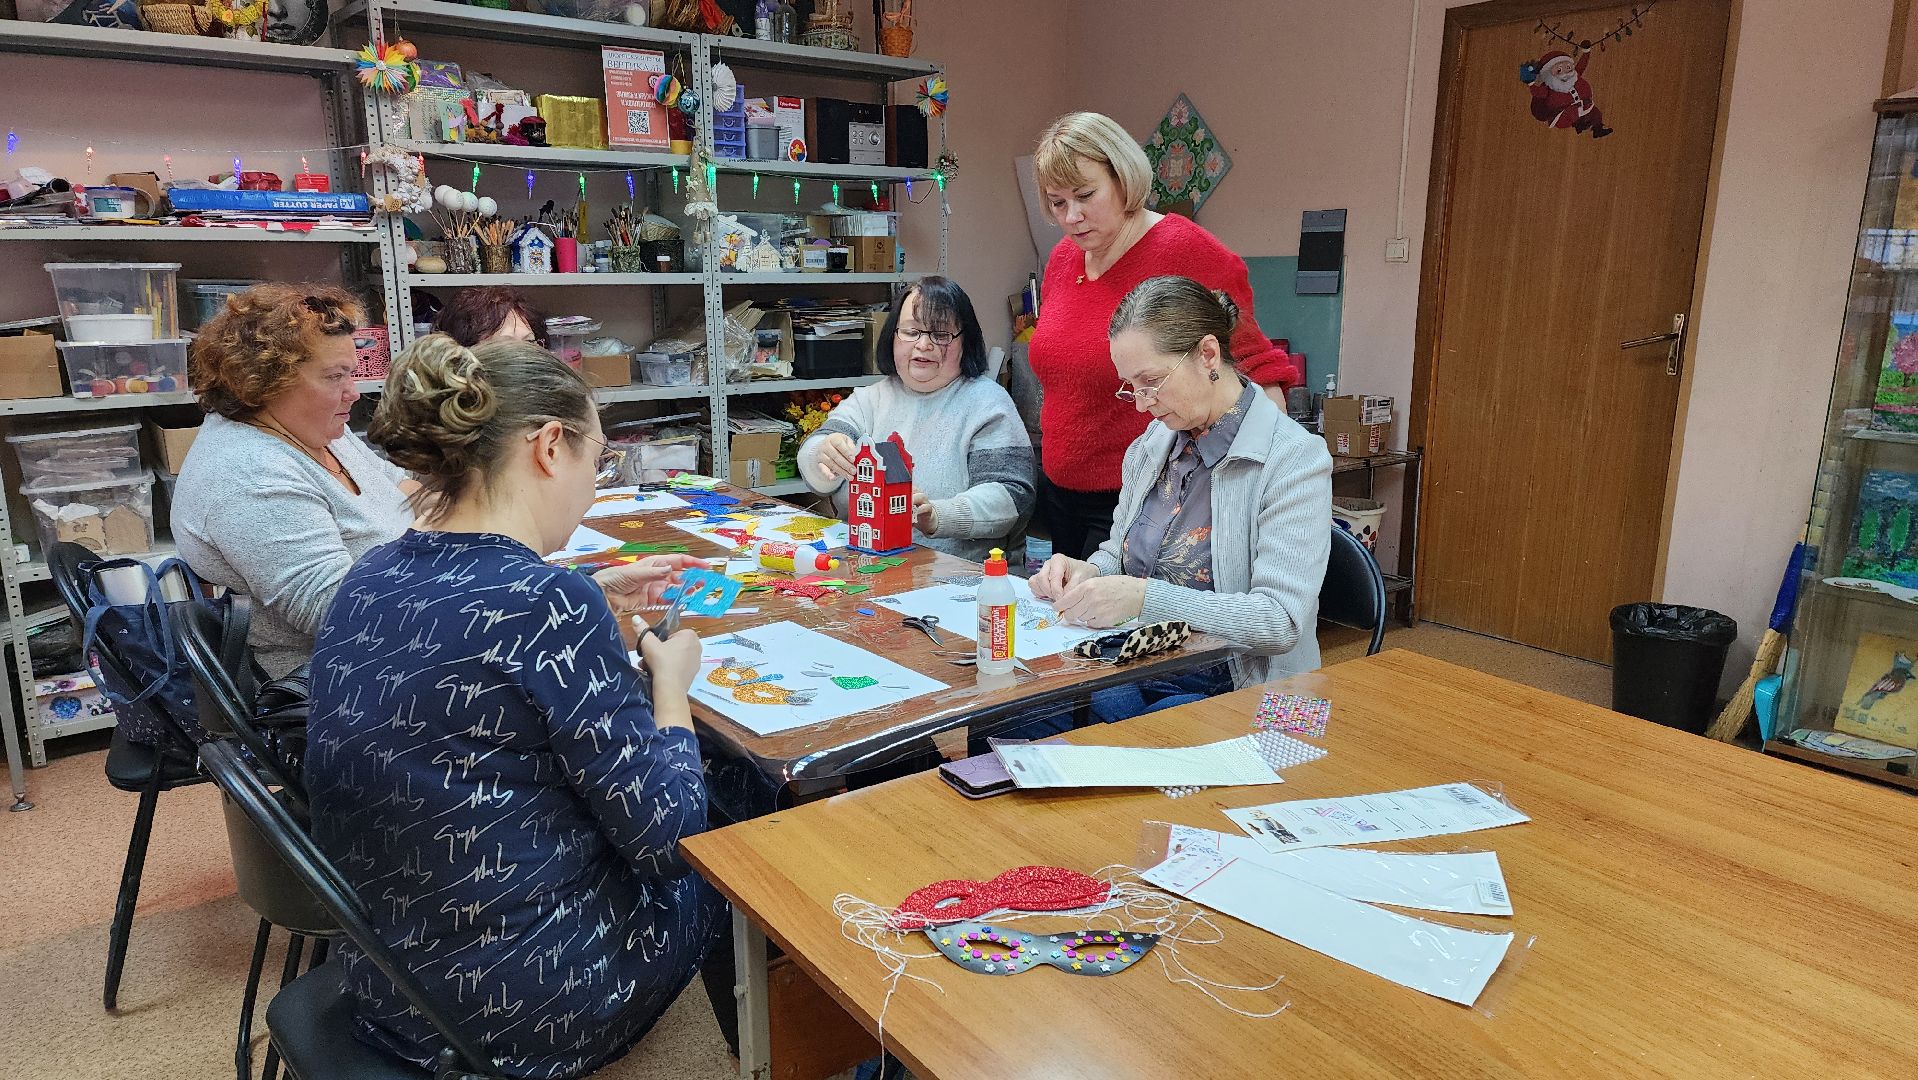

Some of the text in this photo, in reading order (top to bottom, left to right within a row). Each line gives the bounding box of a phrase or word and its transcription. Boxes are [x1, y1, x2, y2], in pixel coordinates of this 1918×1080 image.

[607, 60, 662, 72] ВЕРТИКАЛЬ
[273, 200, 308, 209] CUTTER
[311, 200, 338, 209] PAPER
